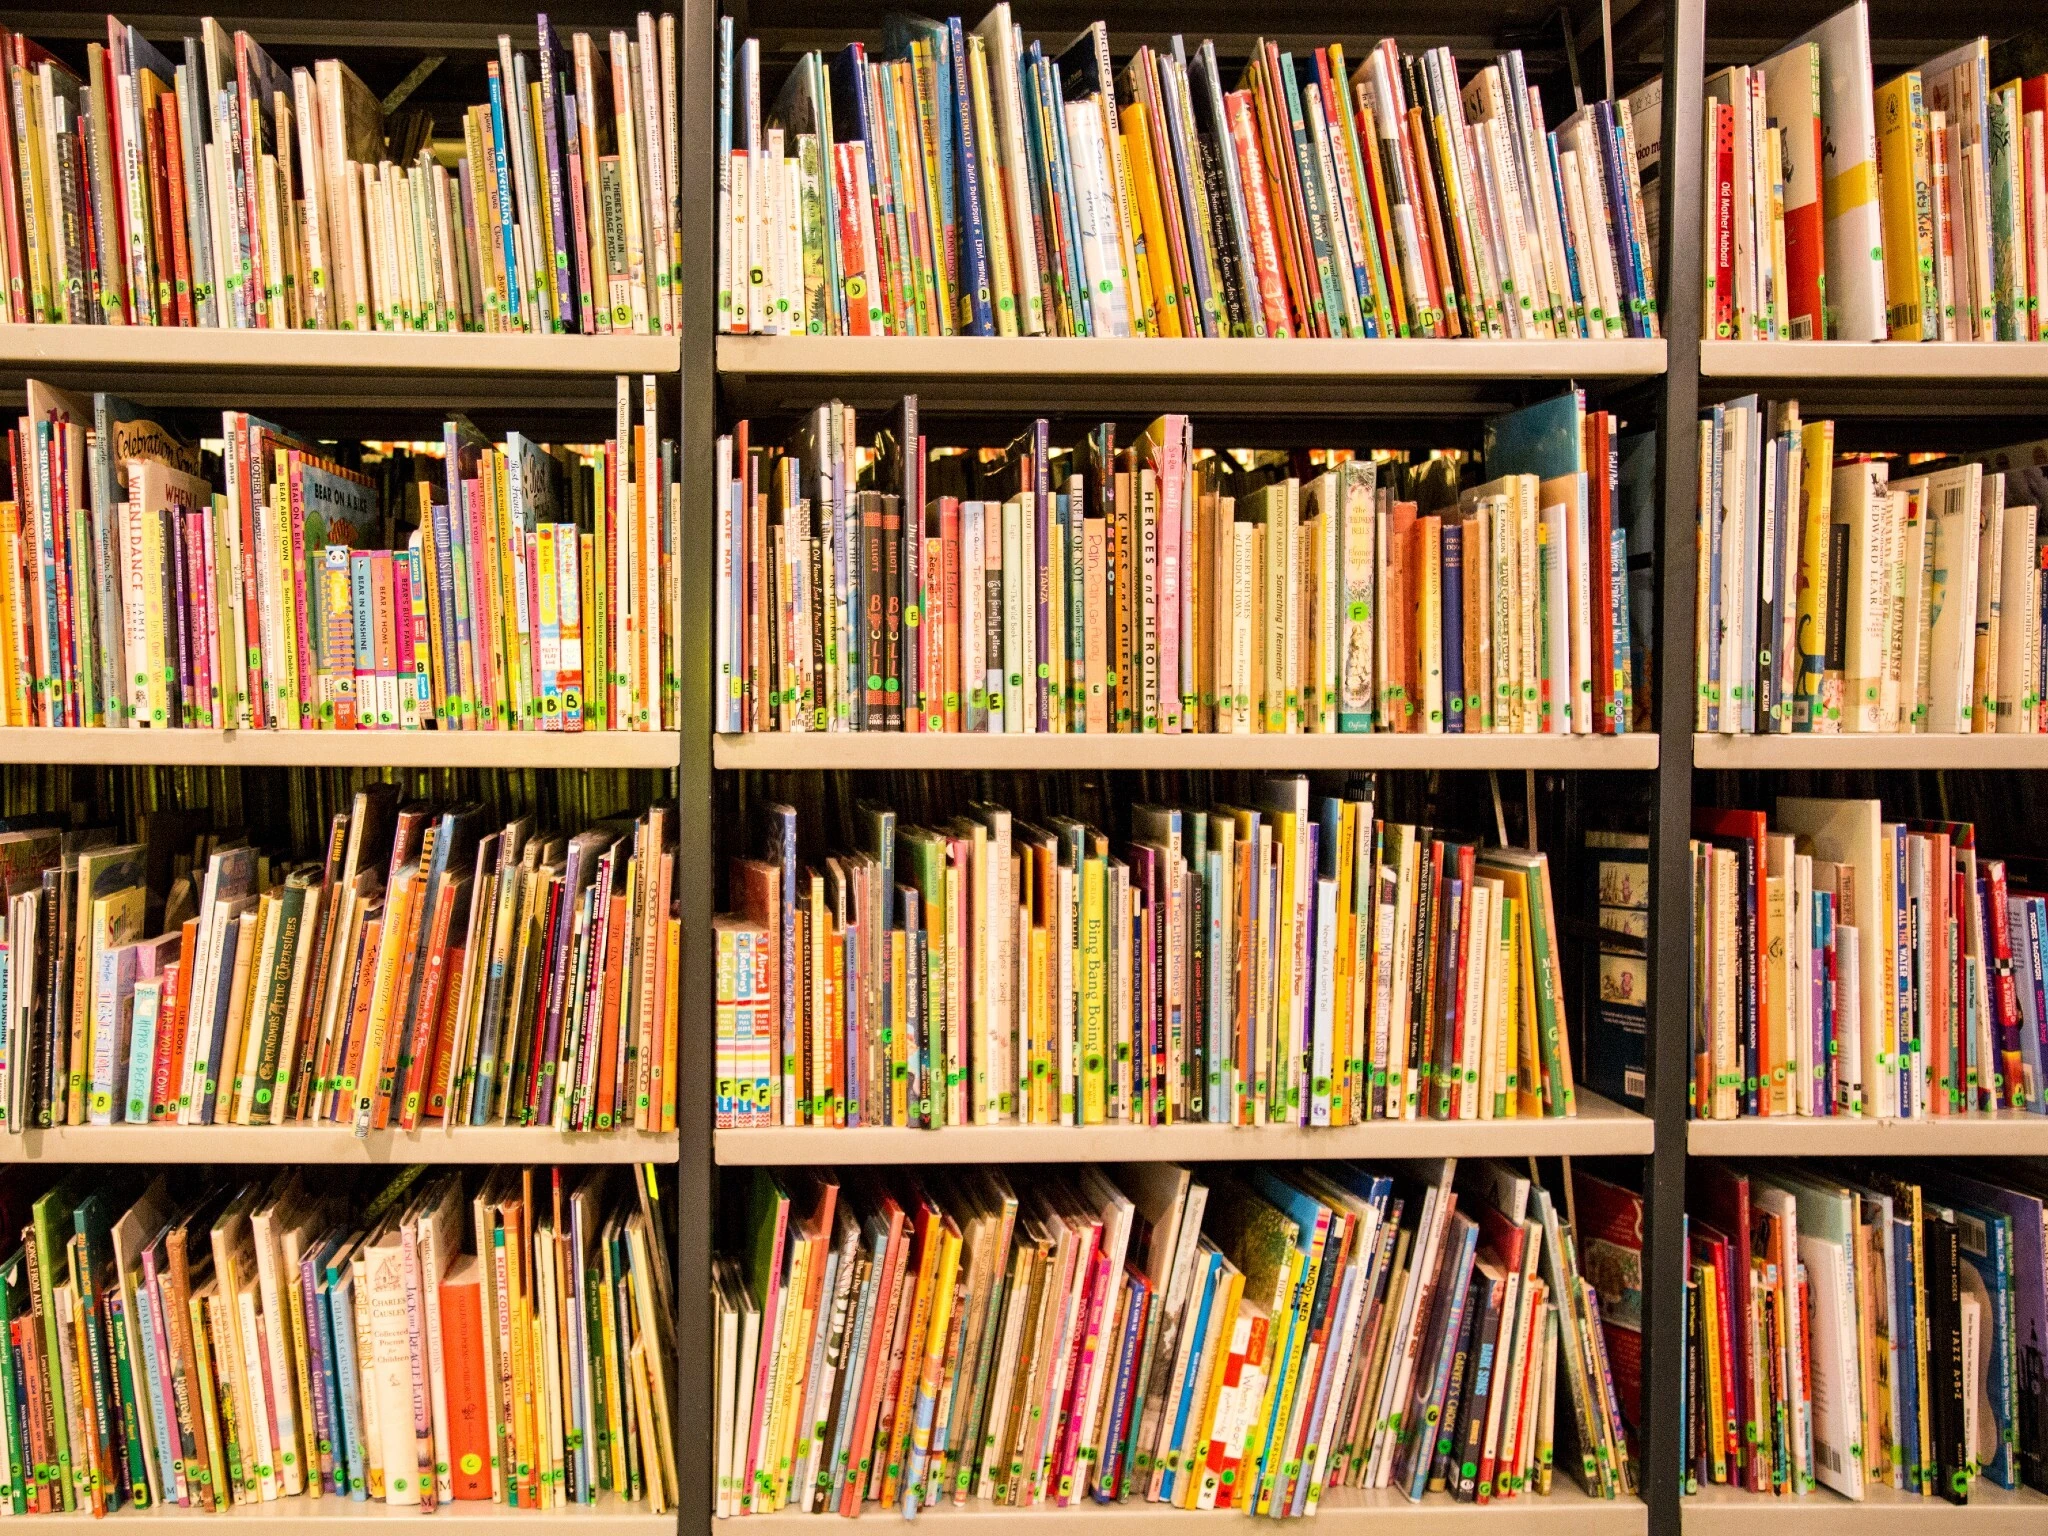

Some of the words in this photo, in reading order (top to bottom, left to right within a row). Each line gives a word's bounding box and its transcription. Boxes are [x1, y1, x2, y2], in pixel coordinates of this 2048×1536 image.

[539, 30, 547, 47] The
[540, 50, 552, 99] Creature
[955, 56, 968, 97] SINGING
[1098, 28, 1111, 77] Picture
[1106, 93, 1118, 130] Poem
[959, 100, 973, 148] MERMAID
[496, 149, 506, 164] To
[1116, 153, 1124, 173] GINA
[550, 170, 560, 196] Helen
[603, 176, 612, 192] THE
[966, 164, 976, 183] JULIA
[497, 166, 511, 225] Everything
[613, 182, 621, 214] THERE'S
[1118, 176, 1130, 230] DOUTHWAITE
[1721, 182, 1730, 196] Old
[1916, 182, 1928, 209] City
[552, 198, 562, 217] Bate
[604, 194, 615, 232] CABBAGE
[968, 186, 980, 225] DONALDSON
[1720, 198, 1730, 228] Mother
[615, 223, 624, 240] COW
[1310, 214, 1323, 242] BABY
[1918, 213, 1930, 238] Kids
[607, 233, 617, 262] PATCH
[617, 242, 625, 253] IN
[1720, 230, 1730, 268] Hubbard
[750, 269, 763, 284] D
[977, 260, 988, 286] MONKS
[1547, 261, 1558, 291] OXFORD
[852, 283, 861, 295] D
[617, 307, 627, 321] B
[737, 307, 744, 315] D
[766, 306, 774, 315] D
[780, 300, 788, 313] D
[618, 398, 626, 428] Quentin
[618, 430, 628, 456] Blake's
[252, 456, 262, 495] MOTHER
[510, 460, 519, 481] Best
[129, 476, 141, 520] WHEN
[278, 482, 286, 502] BEAR
[291, 482, 299, 504] BEAR
[510, 485, 522, 519] Friends
[1072, 488, 1082, 516] LIKE
[27, 500, 36, 523] BOOK
[292, 506, 299, 520] ON
[1276, 489, 1284, 528] ELEANOR
[28, 525, 37, 537] OF
[130, 522, 141, 530] I
[436, 517, 449, 547] CLOUD
[1073, 518, 1082, 529] IT
[1144, 492, 1154, 564] HEROES
[1870, 504, 1879, 563] EDWARD
[101, 528, 110, 572] Celebration
[281, 534, 289, 561] TOWN
[293, 531, 301, 551] BIKE
[1073, 532, 1083, 552] OR
[1275, 530, 1284, 568] FARJEON
[28, 539, 39, 582] RIDDLES
[130, 532, 143, 591] DANCE
[438, 551, 452, 591] BUSTING
[724, 549, 732, 577] NATE
[973, 566, 981, 581] THE
[1073, 555, 1083, 585] NOT
[103, 574, 113, 592] Song
[357, 575, 365, 596] BEAR
[946, 570, 958, 609] Island
[972, 585, 981, 607] POET
[1010, 590, 1018, 603] The
[1039, 566, 1048, 604] STANZA
[1144, 574, 1154, 605] and
[1870, 570, 1879, 606] LEAR
[358, 598, 365, 607] IN
[380, 606, 386, 617] AT
[1010, 605, 1018, 620] Wild
[1274, 574, 1285, 624] Something
[1353, 606, 1362, 619] F
[402, 605, 410, 626] BUSY
[443, 597, 454, 639] MALORIE
[910, 611, 917, 621] E
[972, 611, 981, 634] SLAVE
[358, 609, 368, 651] SUNSHINE
[380, 620, 388, 644] HOME
[402, 627, 412, 658] FAMILY
[1010, 623, 1018, 639] Book
[1890, 599, 1905, 681] NONSENSE
[974, 643, 981, 656] OF
[1275, 633, 1285, 680] Remember
[417, 661, 424, 673] B
[445, 642, 458, 690] BLACKMAN
[974, 658, 982, 681] CUBA
[1145, 617, 1155, 713] HEROINES
[547, 699, 557, 712] B
[566, 693, 578, 709] B
[332, 829, 344, 862] BREATHED
[1173, 904, 1181, 924] Two
[1381, 912, 1392, 940] When
[1898, 909, 1907, 925] ALL
[2029, 912, 2038, 940] ROGER
[1086, 918, 1100, 955] Bing
[1172, 927, 1181, 951] Little
[1379, 942, 1390, 956] My
[1899, 928, 1907, 945] THE
[559, 945, 568, 972] Robert
[646, 935, 656, 985] FREEDOM
[908, 933, 917, 974] Relatively
[1717, 947, 1725, 976] Tinker
[1899, 948, 1908, 977] WATER
[2030, 941, 2042, 980] McGOUGH
[721, 952, 730, 993] Builders
[738, 953, 750, 992] Railway
[756, 952, 767, 989] Airport
[1086, 959, 1100, 1000] Bang
[1171, 955, 1181, 997] Monkeys
[1379, 959, 1390, 989] Sister
[552, 974, 565, 1014] Browning
[644, 989, 652, 1019] OVER
[907, 978, 917, 1018] Speaking
[1717, 979, 1725, 1008] Tailor
[1900, 991, 1908, 1009] THE
[444, 972, 462, 1044] GOODNIGHT
[643, 1022, 651, 1036] ME
[1086, 1006, 1100, 1052] Boing
[1717, 1010, 1725, 1042] Soldier
[1900, 1012, 1908, 1043] WORLD
[1374, 1031, 1386, 1065] Kissing
[1716, 1044, 1725, 1070] Sailor
[437, 1051, 450, 1088] MOON
[720, 1080, 731, 1096] F
[740, 1084, 751, 1100] F
[759, 1089, 768, 1103] F
[26, 1240, 36, 1265] SONGS
[404, 1233, 414, 1276] CAUSLEY
[29, 1267, 39, 1293] FROM
[497, 1257, 506, 1294] KENTE
[1303, 1265, 1318, 1297] NUDDY
[33, 1296, 42, 1318] ALICE
[498, 1297, 509, 1336] COLORS
[1299, 1302, 1310, 1322] NED
[140, 1298, 151, 1343] CHARLES
[146, 1345, 158, 1388] CAUSLEY
[1480, 1343, 1494, 1366] DARK
[1952, 1330, 1960, 1363] JAZZ
[1450, 1351, 1467, 1398] GARVEY'S
[1475, 1368, 1489, 1395] SONS
[762, 1351, 779, 1427] INSTRUCTIONS
[1443, 1400, 1458, 1432] CHOICE
